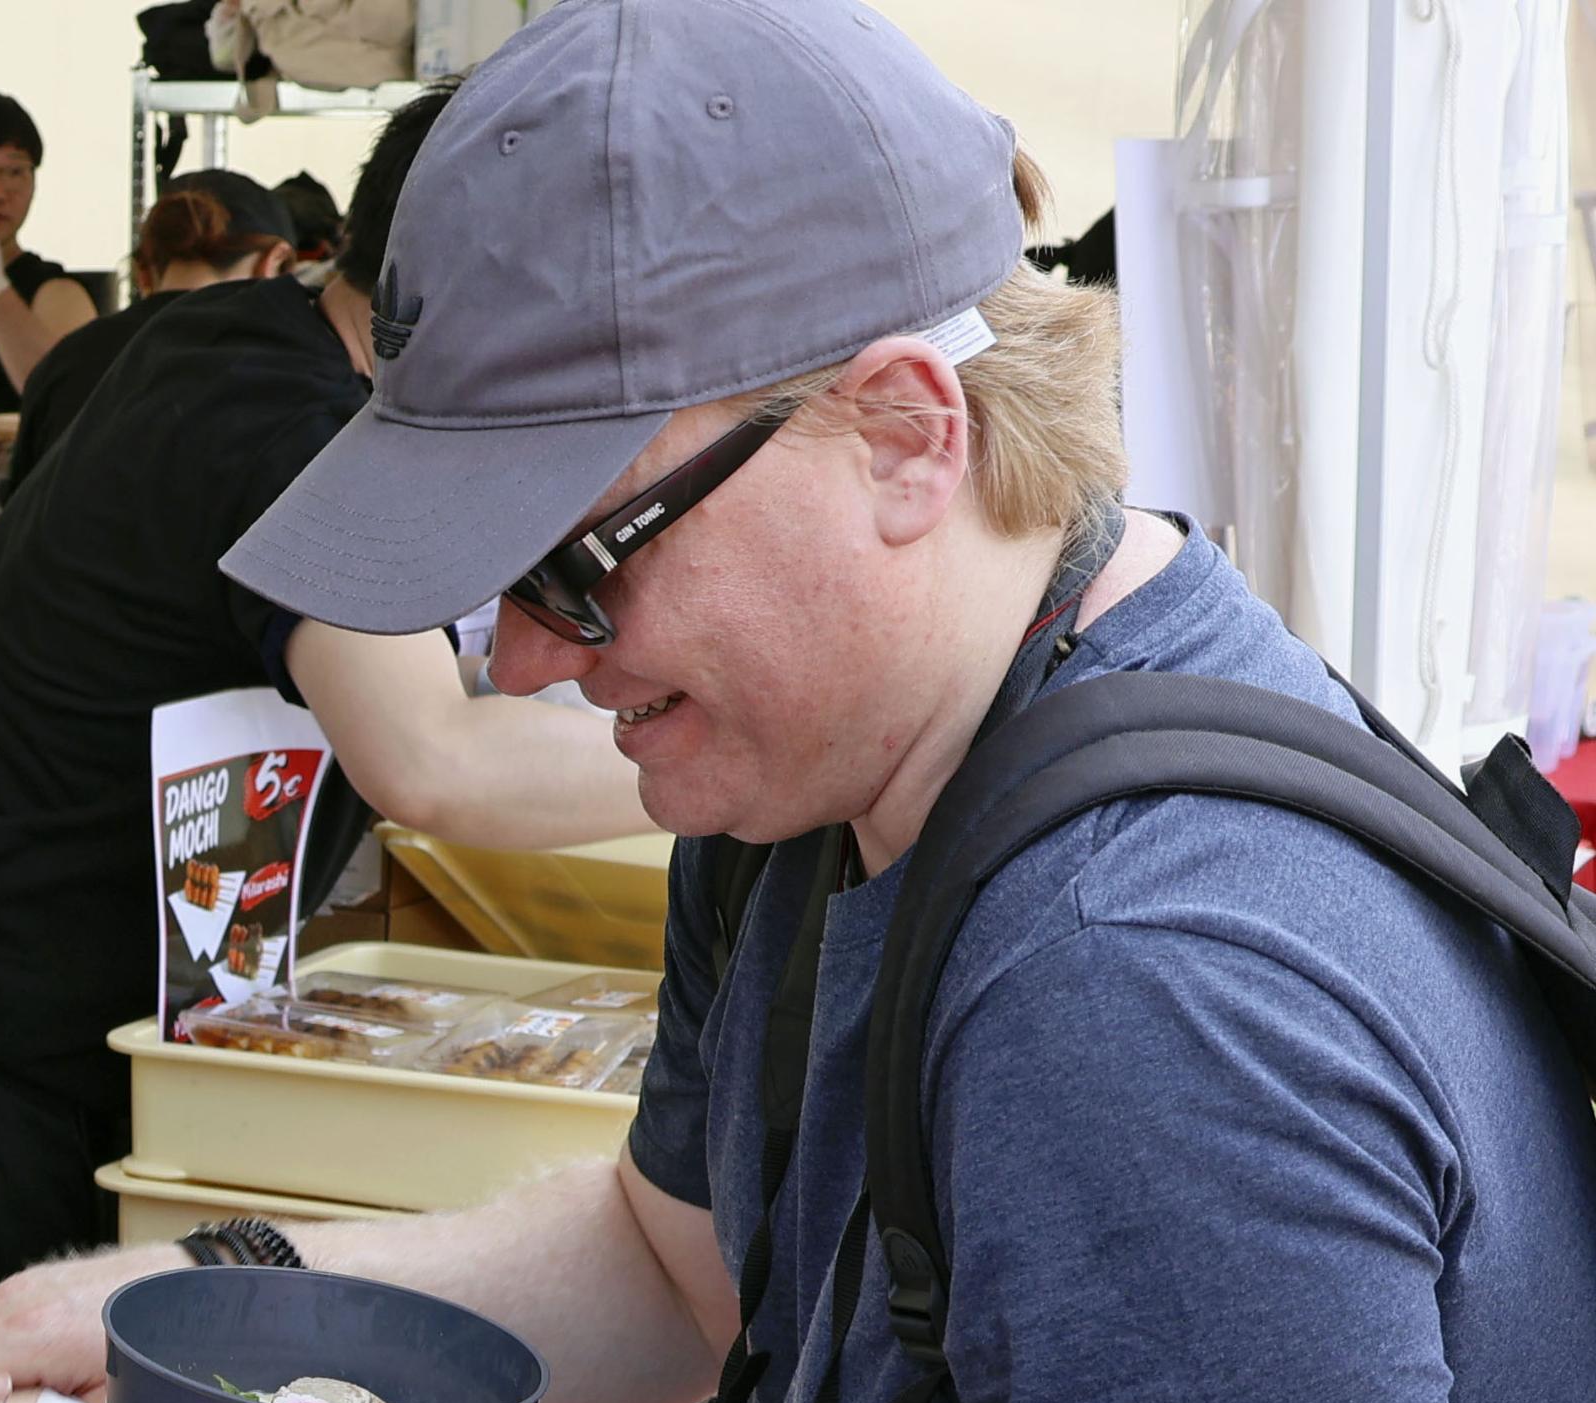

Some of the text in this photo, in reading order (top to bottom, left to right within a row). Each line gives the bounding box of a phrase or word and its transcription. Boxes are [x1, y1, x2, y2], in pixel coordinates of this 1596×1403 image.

[615, 502, 667, 543] GIN TONIC
[165, 768, 230, 826] DANGO
[168, 808, 221, 869] MOCHI
